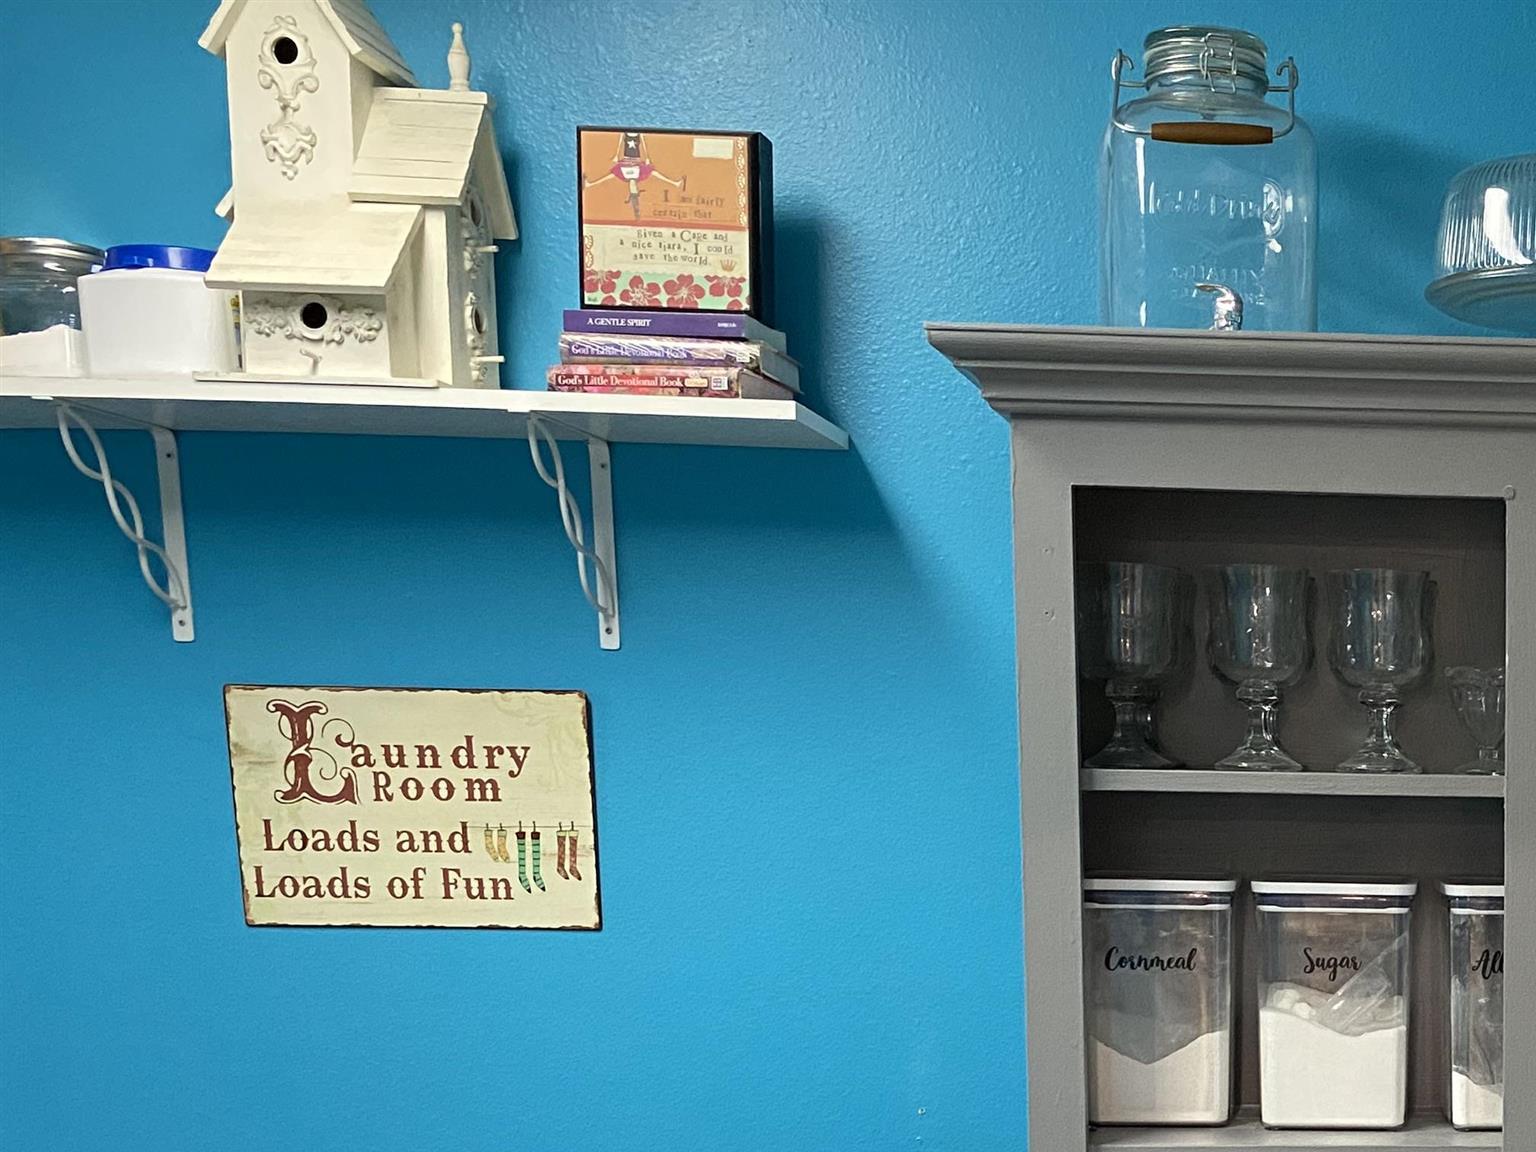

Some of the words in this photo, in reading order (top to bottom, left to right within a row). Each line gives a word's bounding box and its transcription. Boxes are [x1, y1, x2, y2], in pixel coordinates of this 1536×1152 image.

[631, 239, 653, 249] nice
[587, 317, 594, 325] A
[594, 317, 626, 326] GENTLE
[627, 318, 652, 327] SPIRIT
[557, 375, 583, 386] God's
[584, 374, 609, 386] Little
[610, 375, 658, 387] Devotional
[660, 377, 684, 388] Book
[266, 699, 530, 805] Laundry
[373, 771, 502, 802] Room
[263, 819, 380, 852] Loads
[396, 821, 473, 853] and
[254, 865, 372, 899] Loads
[386, 867, 427, 899] of
[441, 868, 515, 900] Fun
[1104, 946, 1197, 971] Cornmeal
[1303, 947, 1362, 980] Sugar
